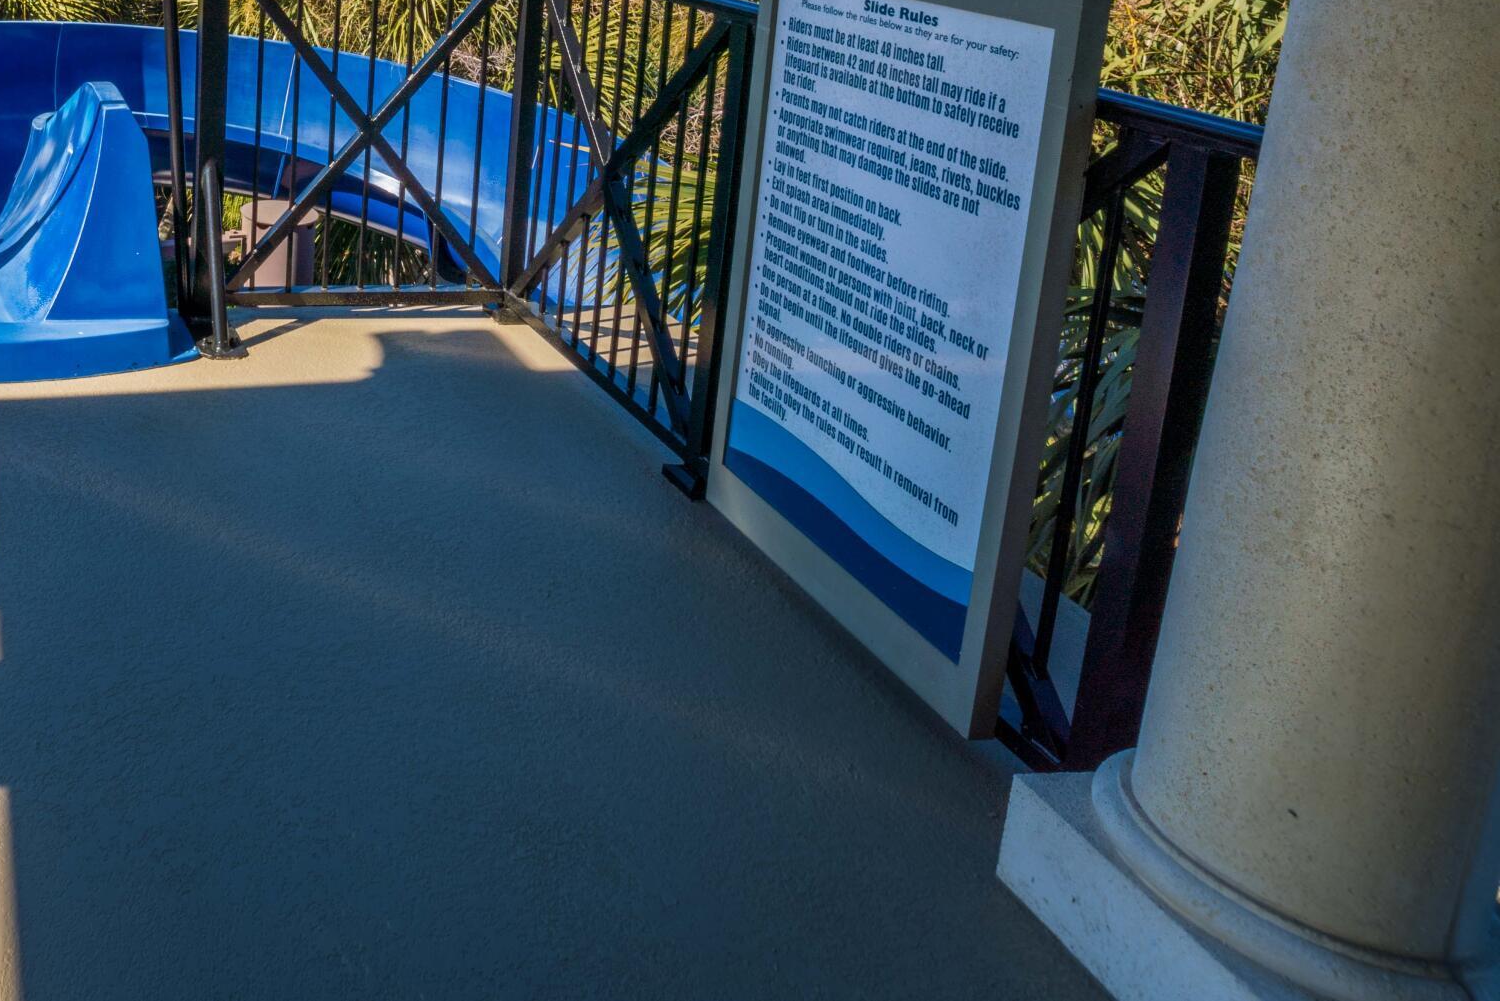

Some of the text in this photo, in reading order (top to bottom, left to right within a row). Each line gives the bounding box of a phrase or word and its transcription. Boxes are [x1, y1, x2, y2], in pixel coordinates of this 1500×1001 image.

[788, 17, 946, 73] Riders must be at least 48 inches tall.
[823, 4, 844, 17] follow
[846, 10, 858, 21] the
[859, 14, 878, 26] rules
[879, 17, 903, 31] below
[904, 26, 913, 34] as
[914, 26, 933, 41] they
[934, 33, 949, 43] are
[950, 34, 964, 46] for
[965, 40, 988, 52] your
[863, 0, 939, 27] Slide Rules
[783, 69, 817, 93] the rider.
[785, 53, 1019, 139] lifeguard is available at the bottom to safely receive
[786, 36, 1006, 114] Riders between 42 and 48 inches tall may ride if a
[777, 124, 980, 217] or anything that may damage the slides are not
[778, 106, 1021, 211] Appropriate swimwear required, jeans, rivets, buckles
[781, 88, 1009, 183] Parents may not catch riders at the end of the slide.
[769, 194, 888, 264] Do not flip or turn in the slides.
[772, 175, 885, 241] Exit splash area immediately.
[773, 157, 902, 227] Lay in feet first position on back.
[764, 246, 937, 354] heart conditions should not ride the slides.
[765, 230, 989, 361] Pregnant women or persons with joint, back, neck or
[768, 212, 950, 318] Remove eyewear and footwear before riding.
[760, 282, 971, 420] Do not begin until the lifeguard gives the go-ahead
[762, 264, 961, 392] One person at a time. No double riders or chains.
[756, 315, 951, 453] No aggressive launching or aggressive behavior.
[750, 367, 958, 527] Failure to obey the rules may result in removal from
